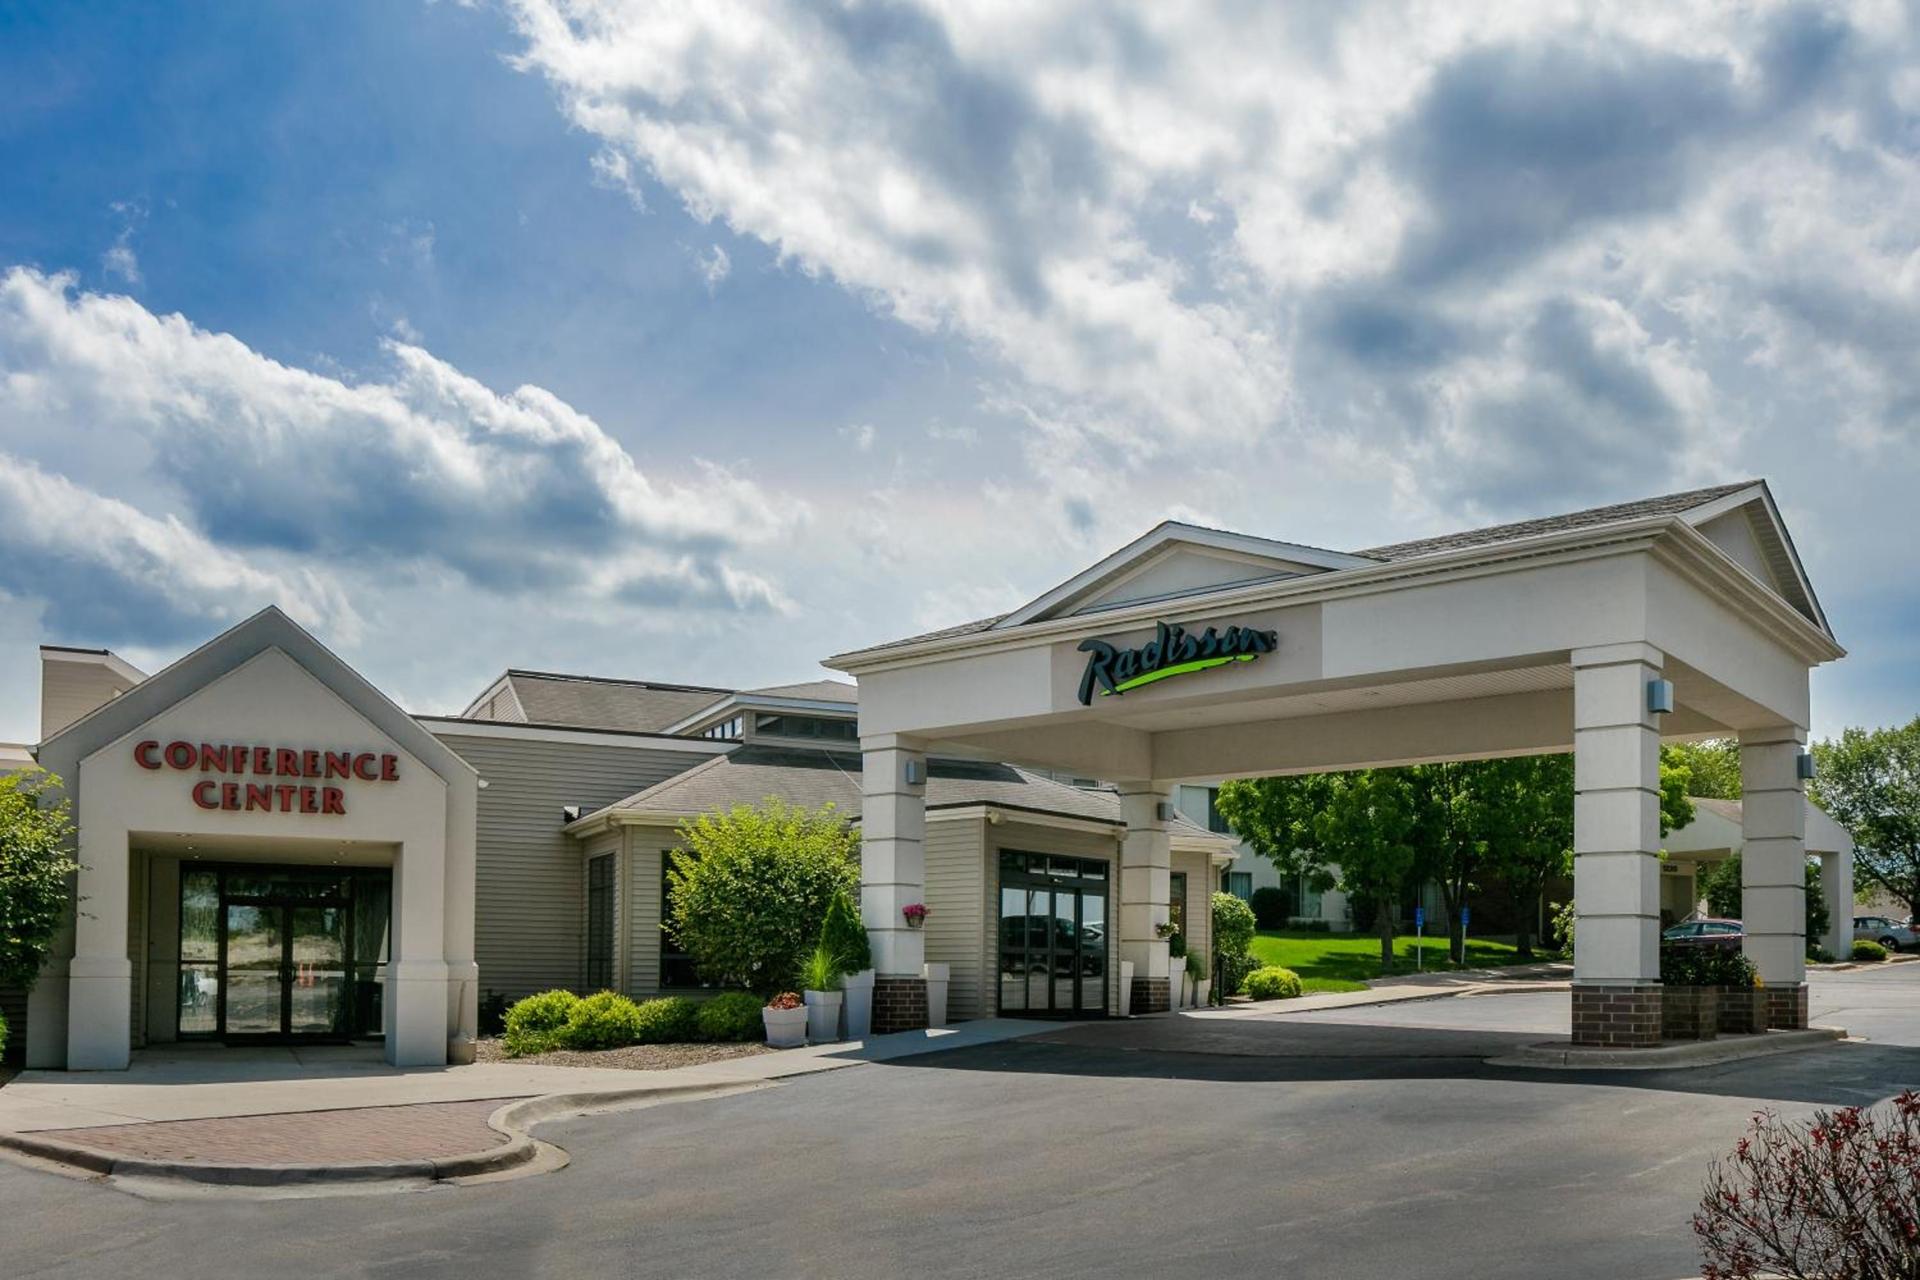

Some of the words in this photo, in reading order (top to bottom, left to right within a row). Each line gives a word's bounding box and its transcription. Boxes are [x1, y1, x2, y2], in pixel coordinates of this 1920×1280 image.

[1077, 620, 1278, 706] Radisson
[134, 740, 400, 781] CONFERENCE
[191, 780, 346, 815] CENTER
